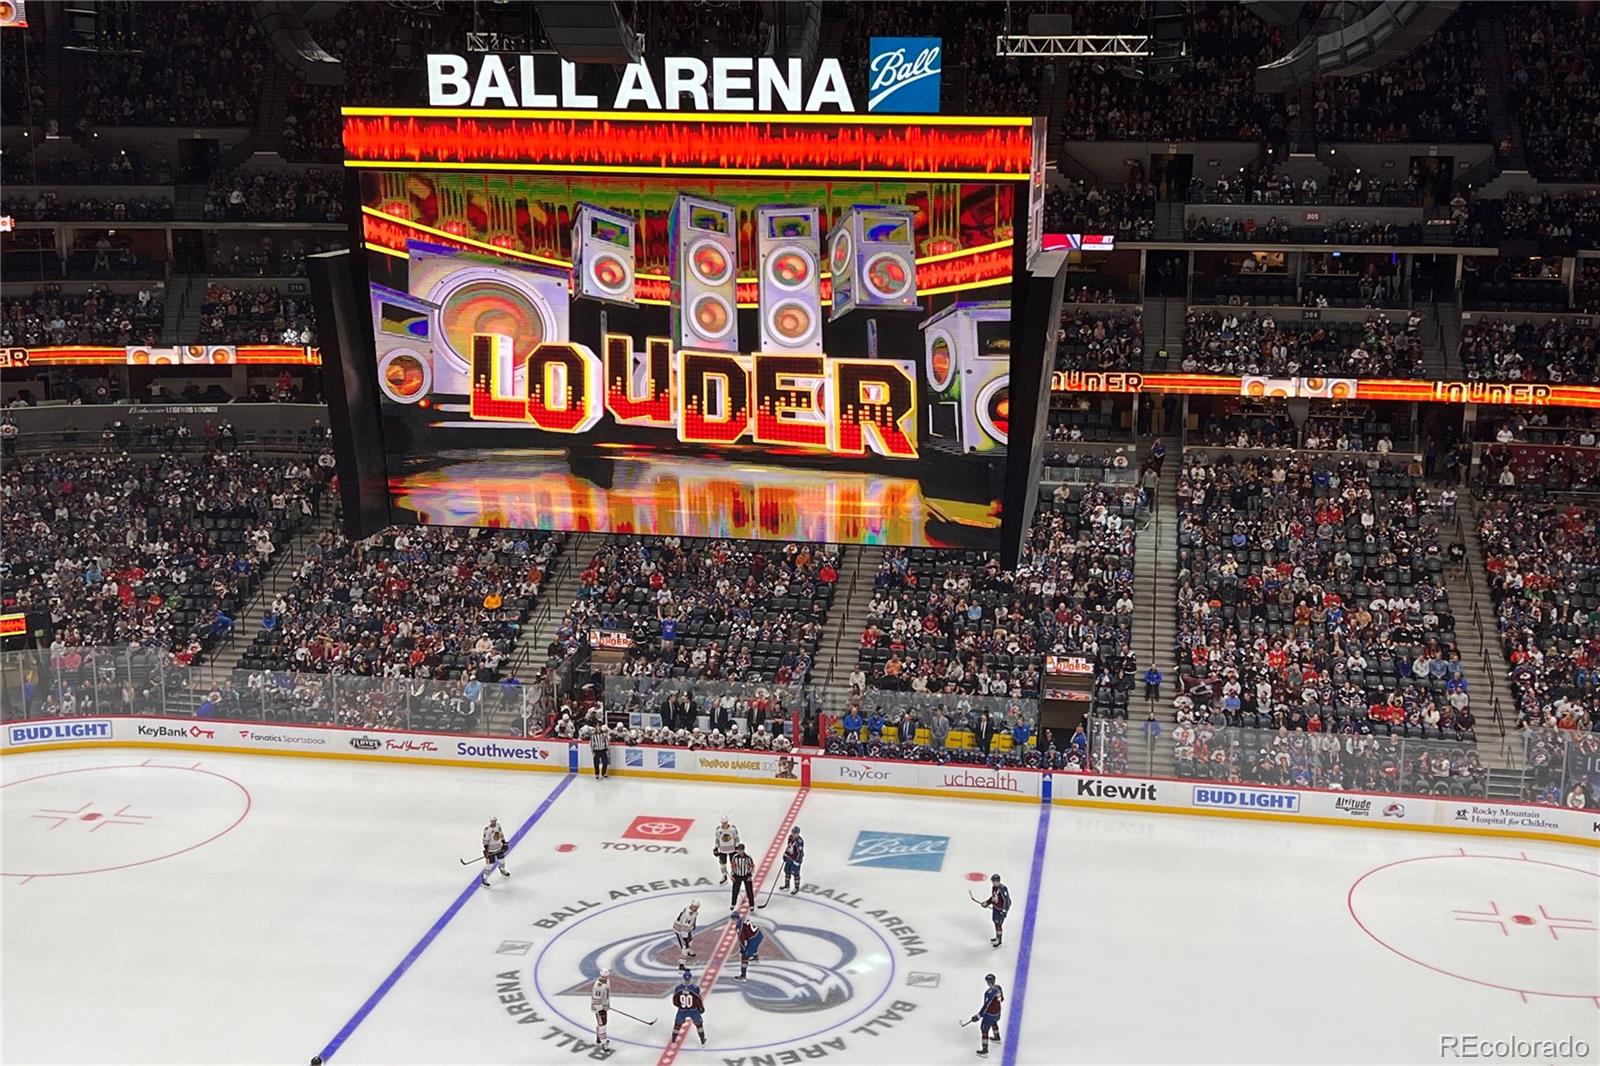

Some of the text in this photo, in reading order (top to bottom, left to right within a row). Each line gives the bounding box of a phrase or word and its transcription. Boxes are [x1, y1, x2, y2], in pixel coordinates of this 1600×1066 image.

[870, 45, 941, 92] Ball
[426, 54, 856, 112] BALL ARENA
[470, 333, 919, 458] LOUDER
[13, 723, 108, 741] BUD LIGHT
[138, 725, 188, 738] KeyBank
[250, 733, 326, 744] Fanatics Sportsbook
[457, 742, 539, 760] Southwest
[840, 765, 891, 781] Paycor
[944, 772, 1018, 791] uchealth
[1077, 779, 1157, 800] Kiewit
[1196, 790, 1296, 808] BUD LIGHT
[1335, 797, 1372, 809] Altitude
[1472, 807, 1540, 818] Rocky Mountain
[1472, 816, 1559, 829] Hospital for Children
[601, 842, 689, 854] TOYOTA
[857, 831, 947, 855] Ball
[533, 876, 713, 930] BALL ARENA
[800, 883, 929, 957] BALL ARENA
[496, 969, 545, 1025] ARENA
[680, 994, 693, 1008] 90
[851, 1000, 918, 1036] BALL
